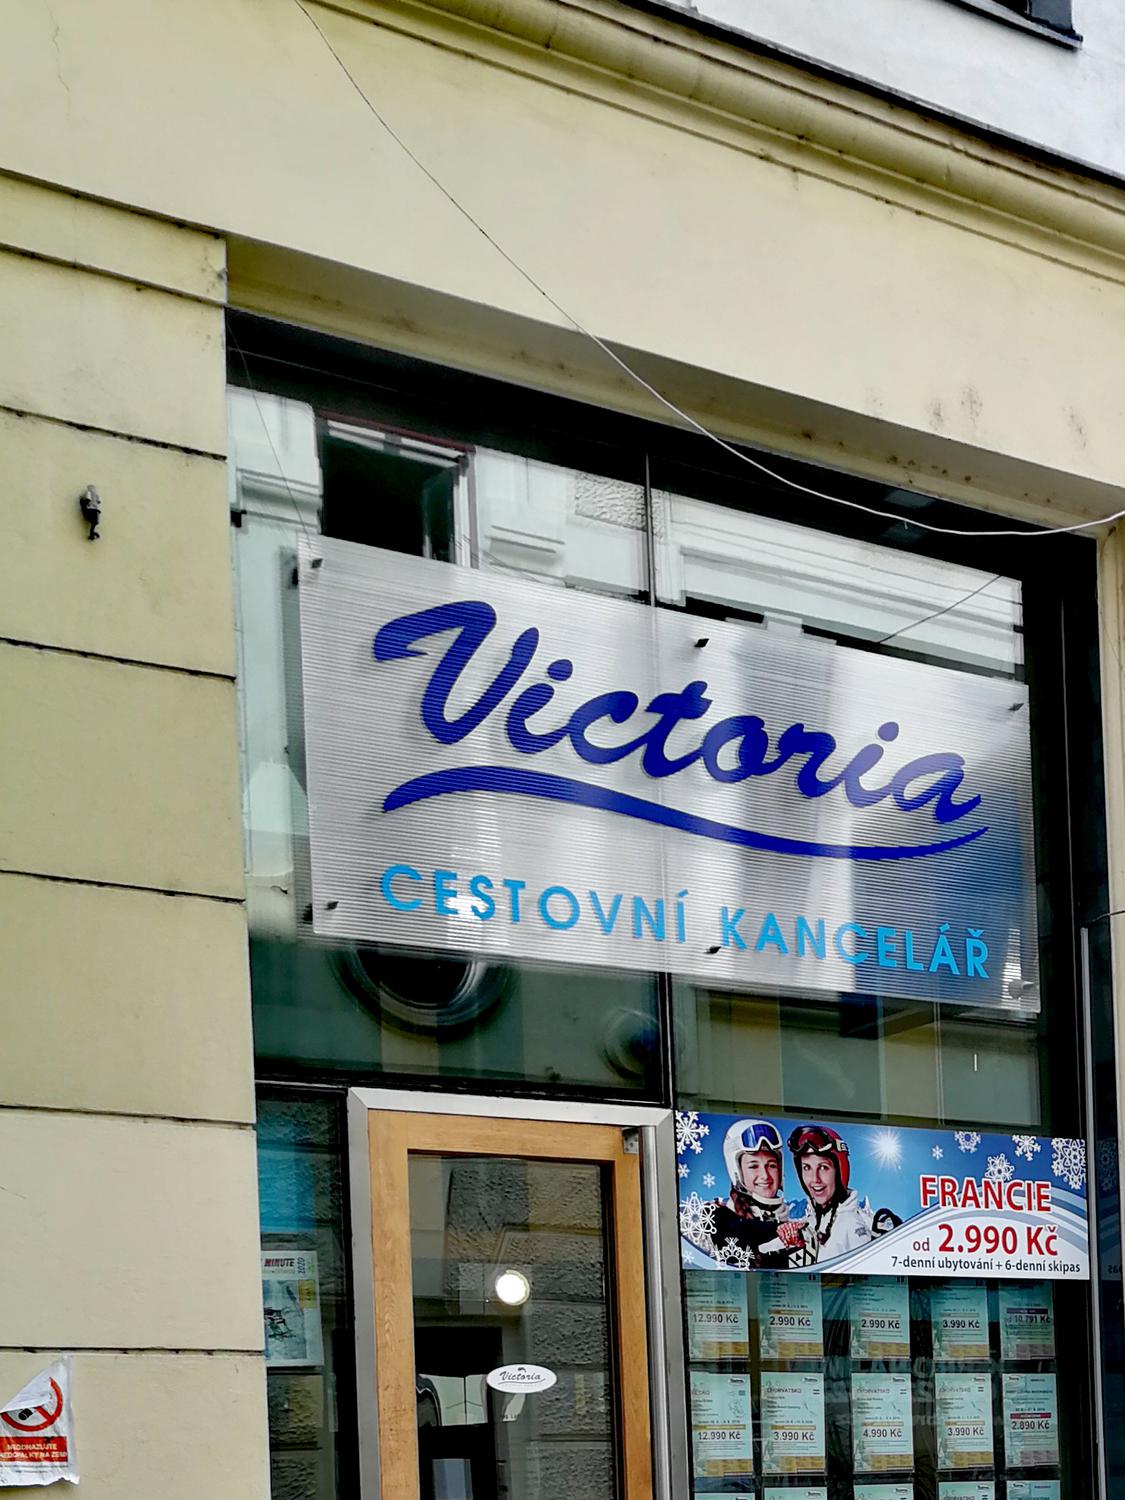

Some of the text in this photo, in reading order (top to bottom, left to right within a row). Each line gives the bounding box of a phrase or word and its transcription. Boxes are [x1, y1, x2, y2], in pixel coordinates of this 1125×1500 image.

[374, 600, 981, 823] Victoria
[381, 864, 990, 980] CESTOVNÍ KANCELÁŘ
[919, 1174, 1053, 1213] FRANCIE
[912, 1223, 1059, 1257] od 2.990 Kč
[891, 1256, 1081, 1275] 7-denní ubytování 6-denní skipas
[693, 1313, 739, 1324] 12.990 Kč
[769, 1316, 811, 1327] 2.990 Kč
[861, 1319, 900, 1329] 2.990 Kč
[942, 1319, 980, 1329] 3.990 Kč
[499, 1371, 542, 1383] Victoria
[1012, 1420, 1050, 1430] 2.890 Kč
[699, 1431, 741, 1441] 12.990 Kč
[774, 1431, 815, 1441] 3.990 Kč
[863, 1428, 902, 1438] 4.990 Kč
[947, 1427, 985, 1437] 3.990 Kč
